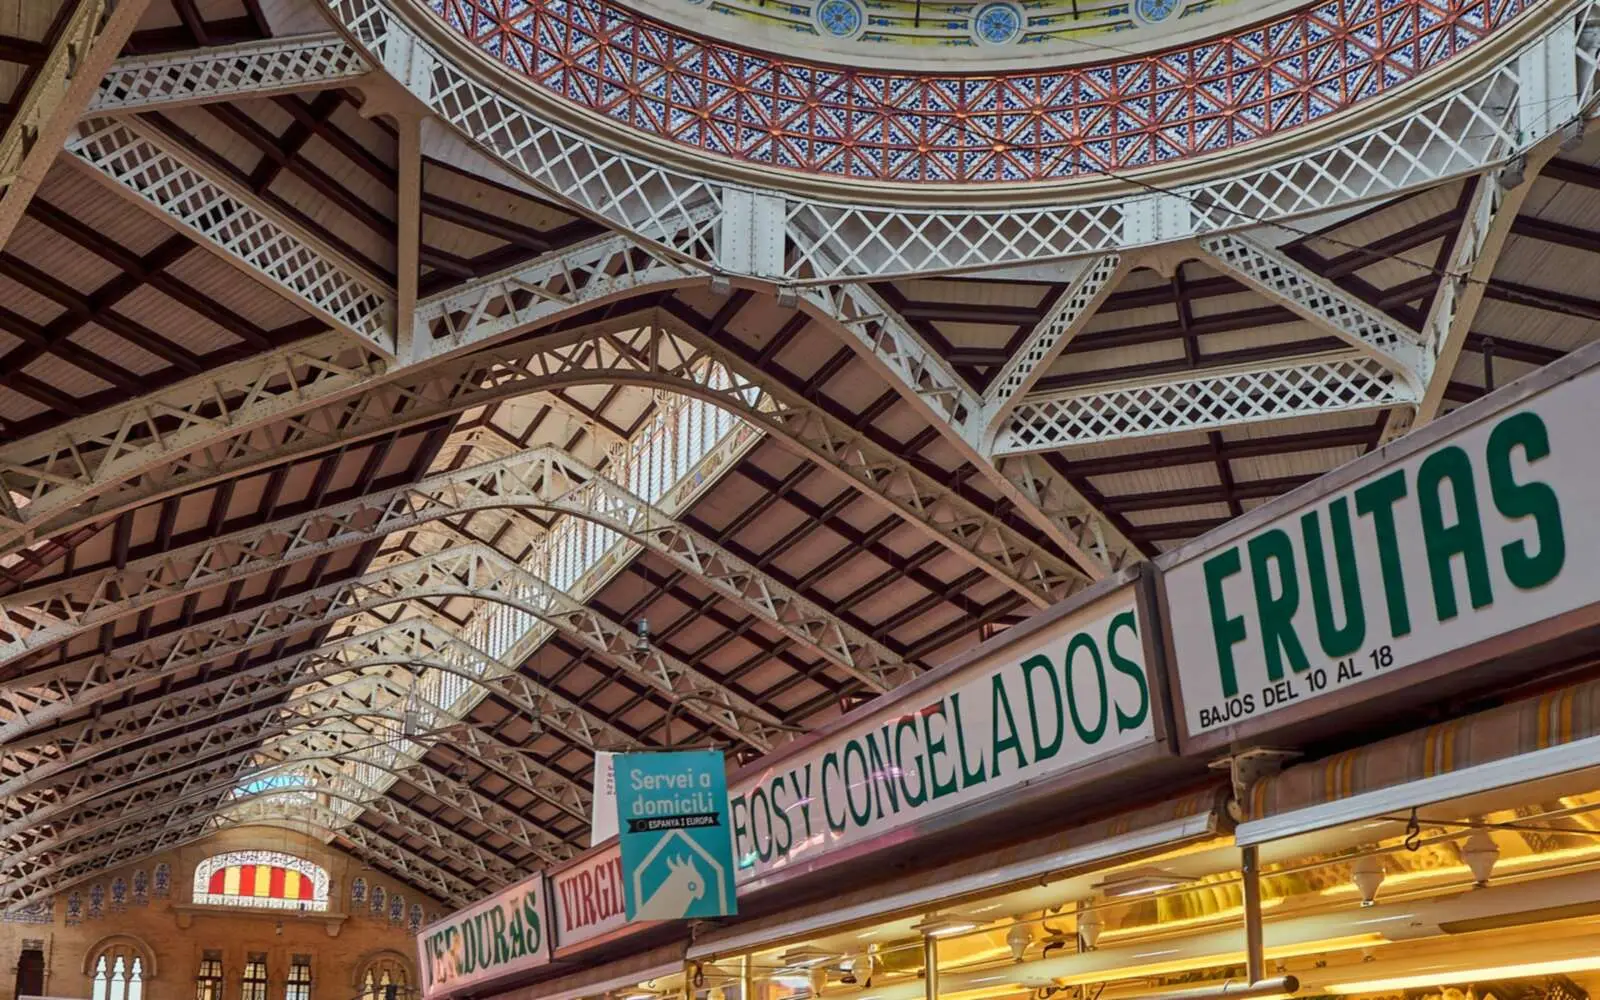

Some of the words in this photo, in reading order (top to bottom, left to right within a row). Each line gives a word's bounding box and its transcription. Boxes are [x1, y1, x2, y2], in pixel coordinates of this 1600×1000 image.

[1203, 412, 1566, 699] FRUTAS
[1200, 694, 1255, 728] BAJOS
[1262, 680, 1299, 707] DEL
[1305, 668, 1327, 692] 10
[1337, 658, 1362, 683] AL
[1369, 645, 1394, 670] 18
[789, 763, 811, 839] Y
[821, 609, 1150, 833] CONGELADOS
[630, 768, 694, 790] Servei
[699, 773, 711, 788] a
[632, 792, 714, 815] domicili
[648, 819, 680, 829] ESPANYA
[686, 816, 714, 826] EUROPA
